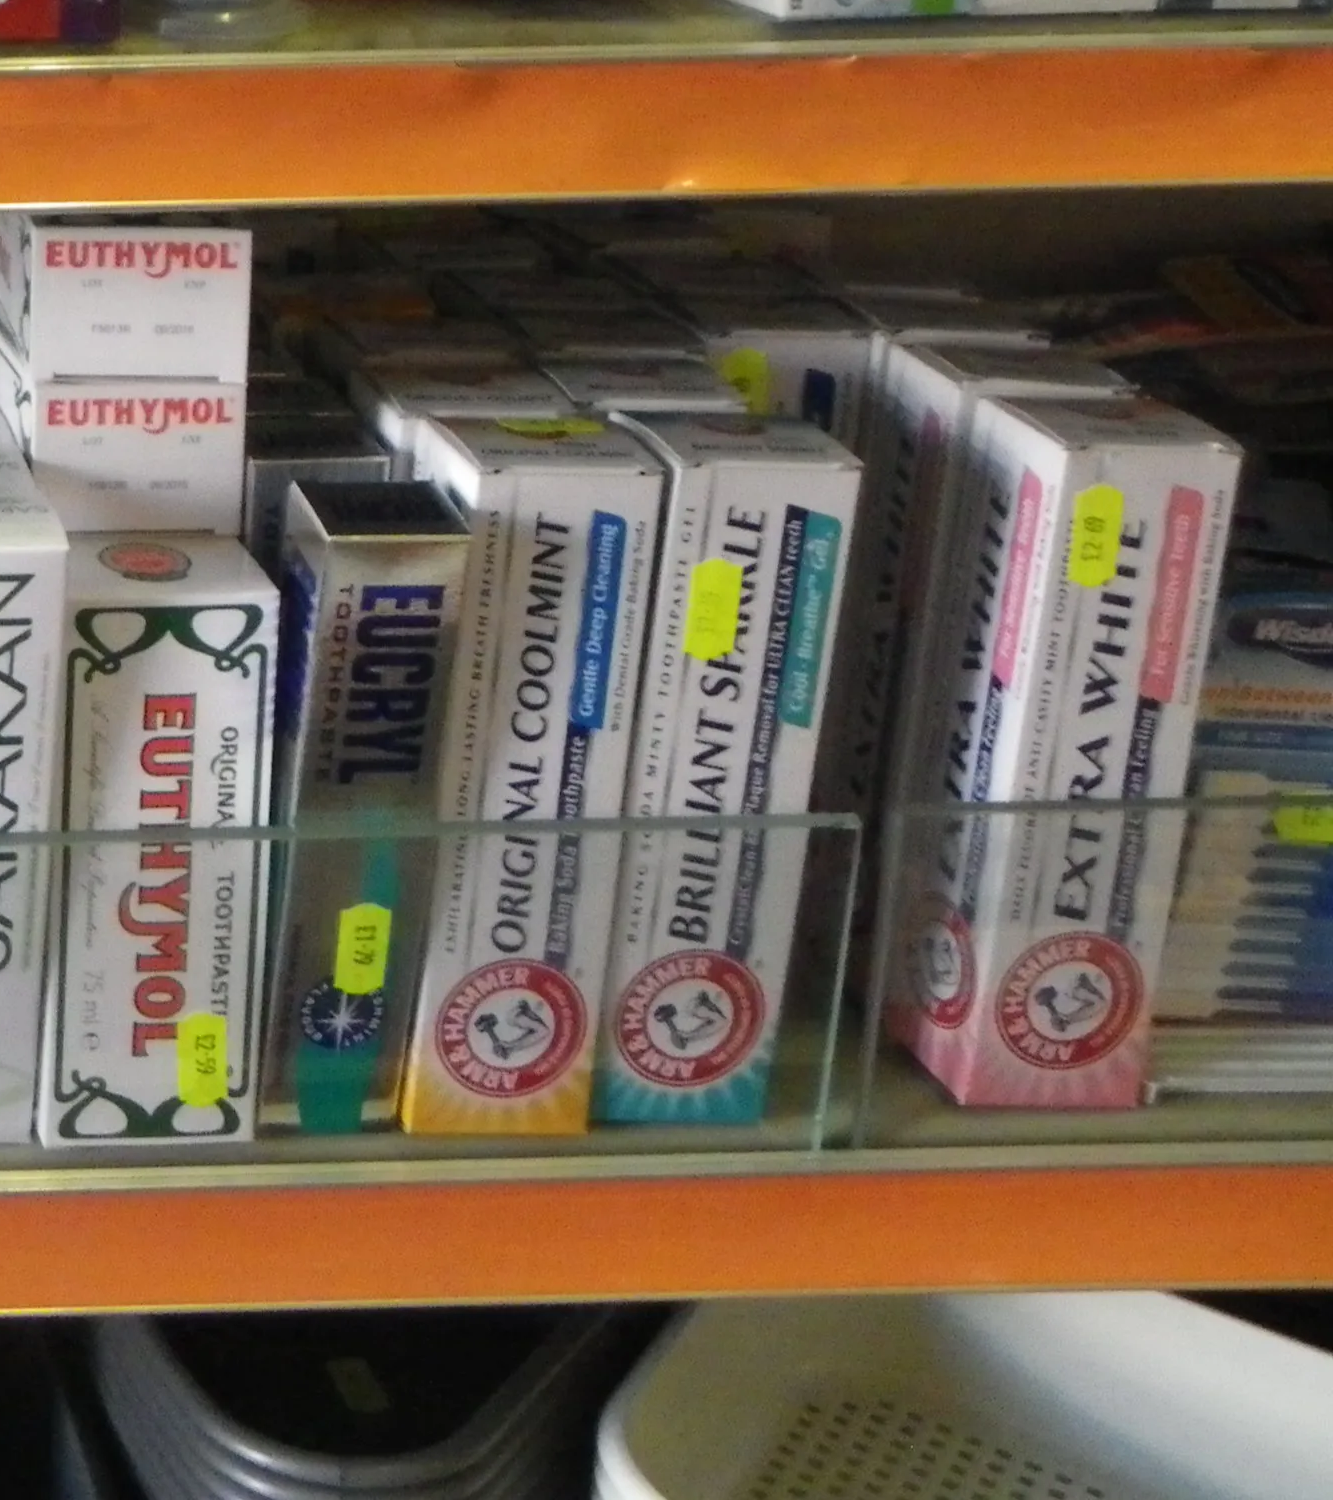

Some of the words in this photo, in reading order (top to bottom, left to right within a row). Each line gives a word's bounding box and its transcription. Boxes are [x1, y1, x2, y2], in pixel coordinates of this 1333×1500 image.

[45, 240, 238, 279] EUTHYMOL
[47, 397, 234, 434] EUTHYMOL
[476, 510, 501, 610] FRESHNESS
[590, 522, 618, 605] Cleaning
[782, 520, 803, 562] teeth
[774, 567, 797, 616] CLEAN
[471, 617, 490, 681] BREATH
[510, 511, 571, 744] COOLMINT
[583, 609, 607, 656] Deep
[766, 620, 789, 669] ULTRA
[577, 661, 600, 717] Gentle
[613, 654, 630, 699] Dental
[644, 711, 665, 777] MINTY
[655, 559, 690, 699] TOOTHPASTE
[461, 689, 482, 762] LASTING
[456, 771, 472, 817] LONG
[668, 708, 733, 944] BRILLIANT
[490, 756, 545, 954] ORIGINAL
